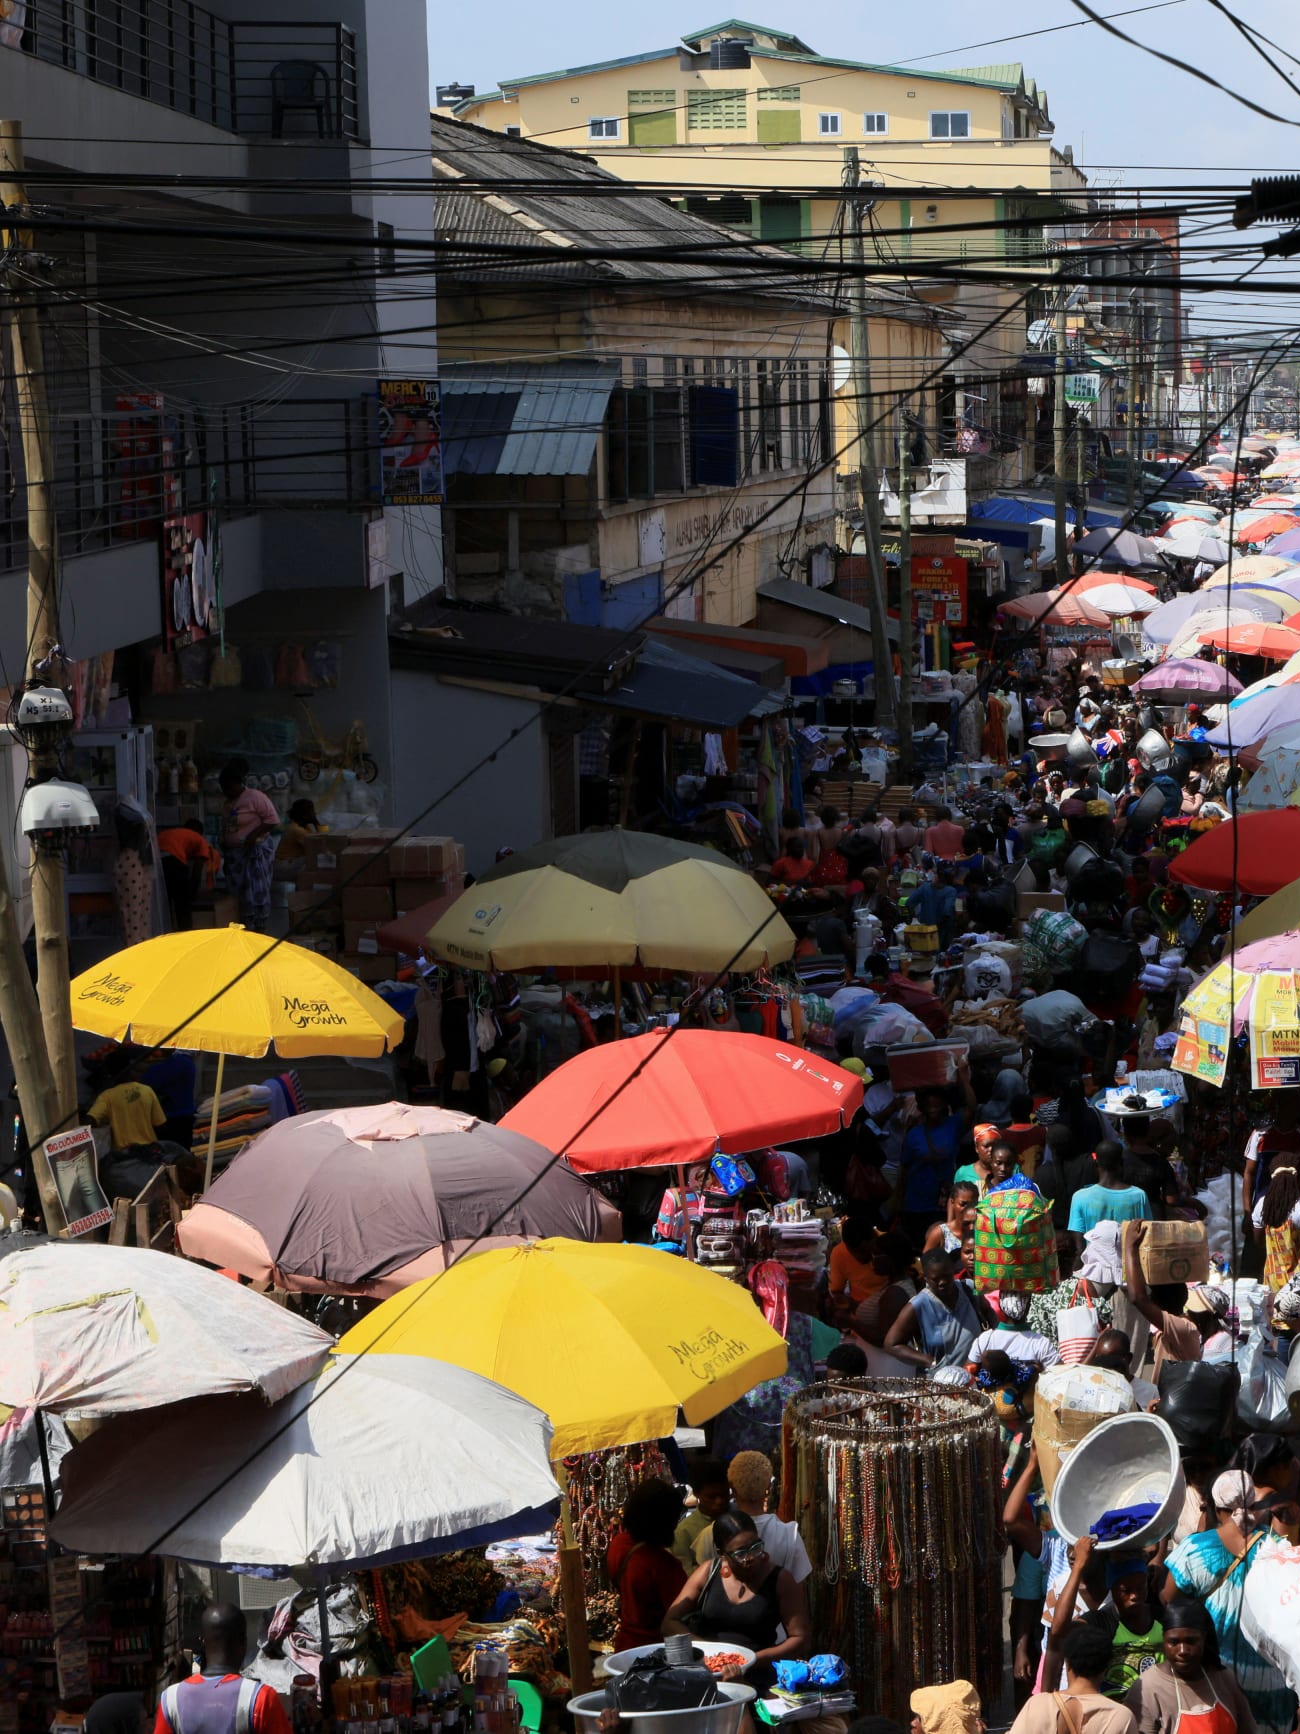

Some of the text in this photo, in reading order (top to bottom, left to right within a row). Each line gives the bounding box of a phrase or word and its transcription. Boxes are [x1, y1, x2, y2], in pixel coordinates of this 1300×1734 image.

[381, 382, 427, 396] MERCY
[94, 972, 132, 994] Mega
[78, 984, 126, 1007] Growth
[281, 995, 330, 1015] Mega
[289, 1010, 347, 1028] Growth
[1272, 1030, 1300, 1039] MTN
[59, 1131, 90, 1149] CUCUMBER
[667, 1330, 724, 1364] Mega
[690, 1339, 750, 1384] Growth
